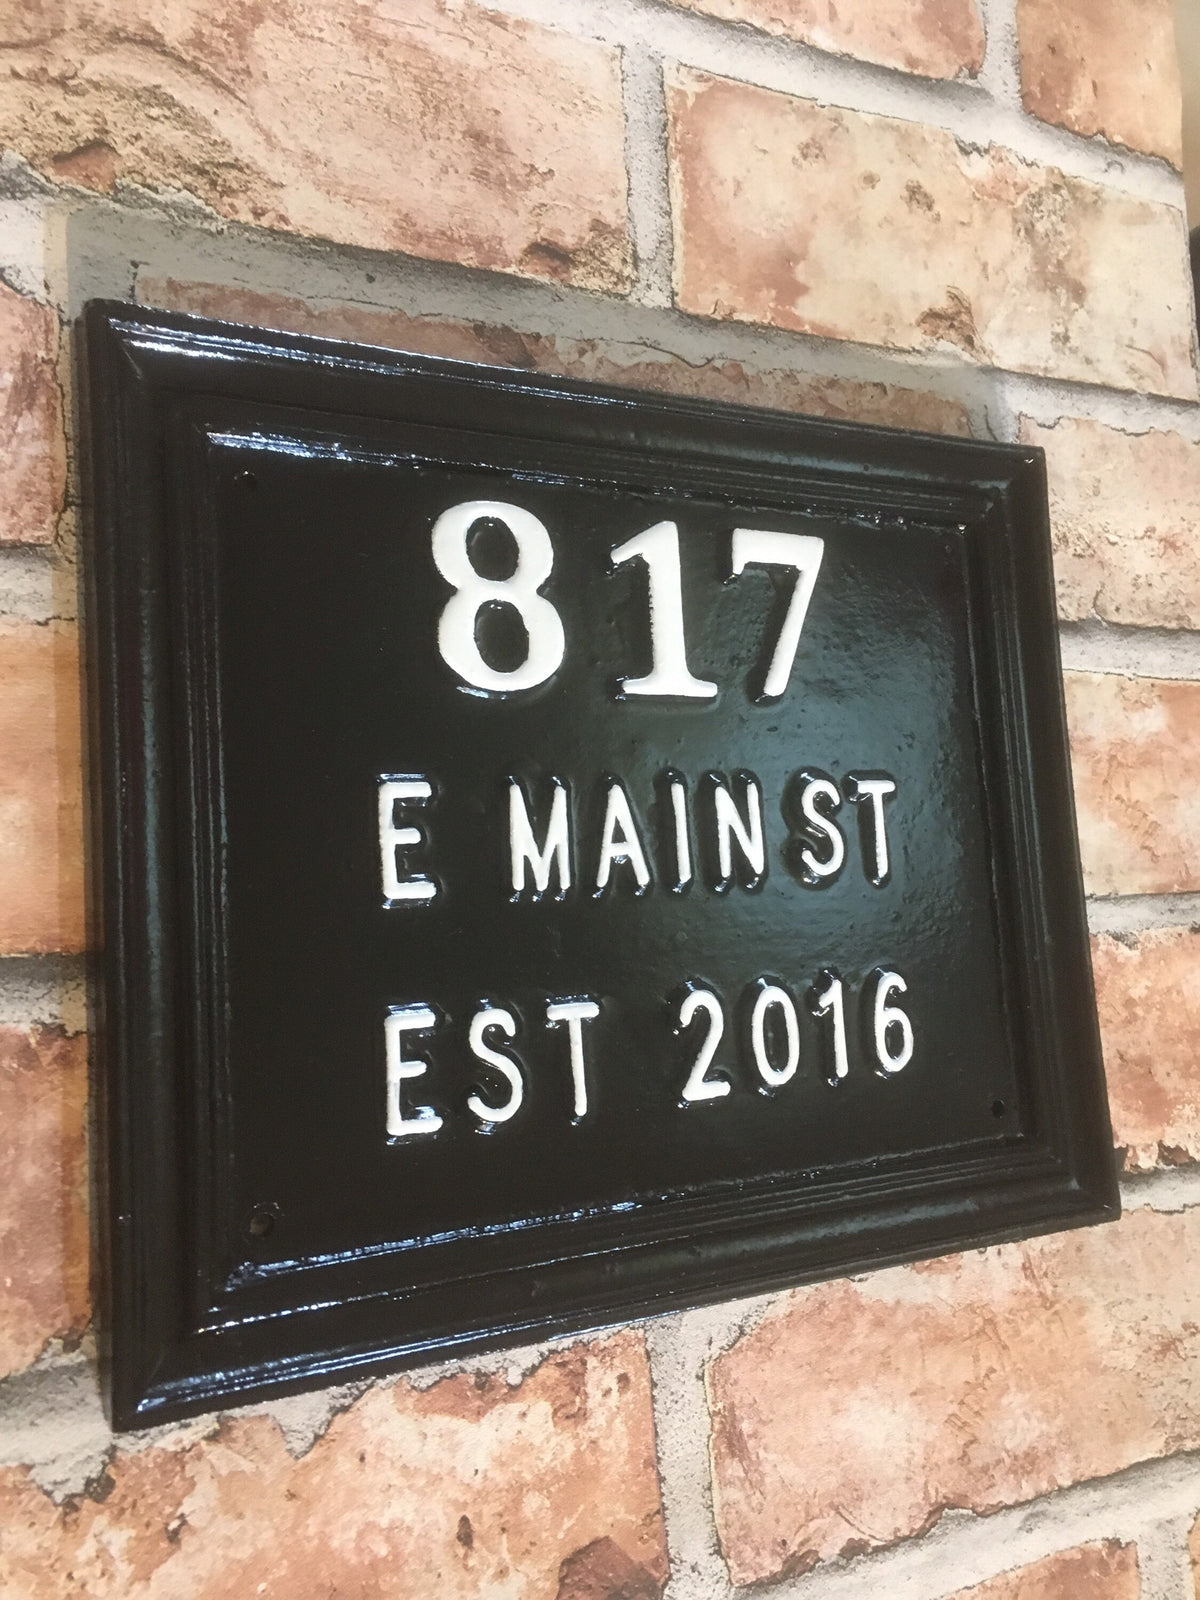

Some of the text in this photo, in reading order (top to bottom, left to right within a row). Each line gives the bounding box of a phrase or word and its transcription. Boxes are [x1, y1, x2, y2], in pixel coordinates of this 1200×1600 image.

[432, 500, 825, 697] 817
[378, 781, 437, 900] E
[384, 967, 914, 1136] EST 2016
